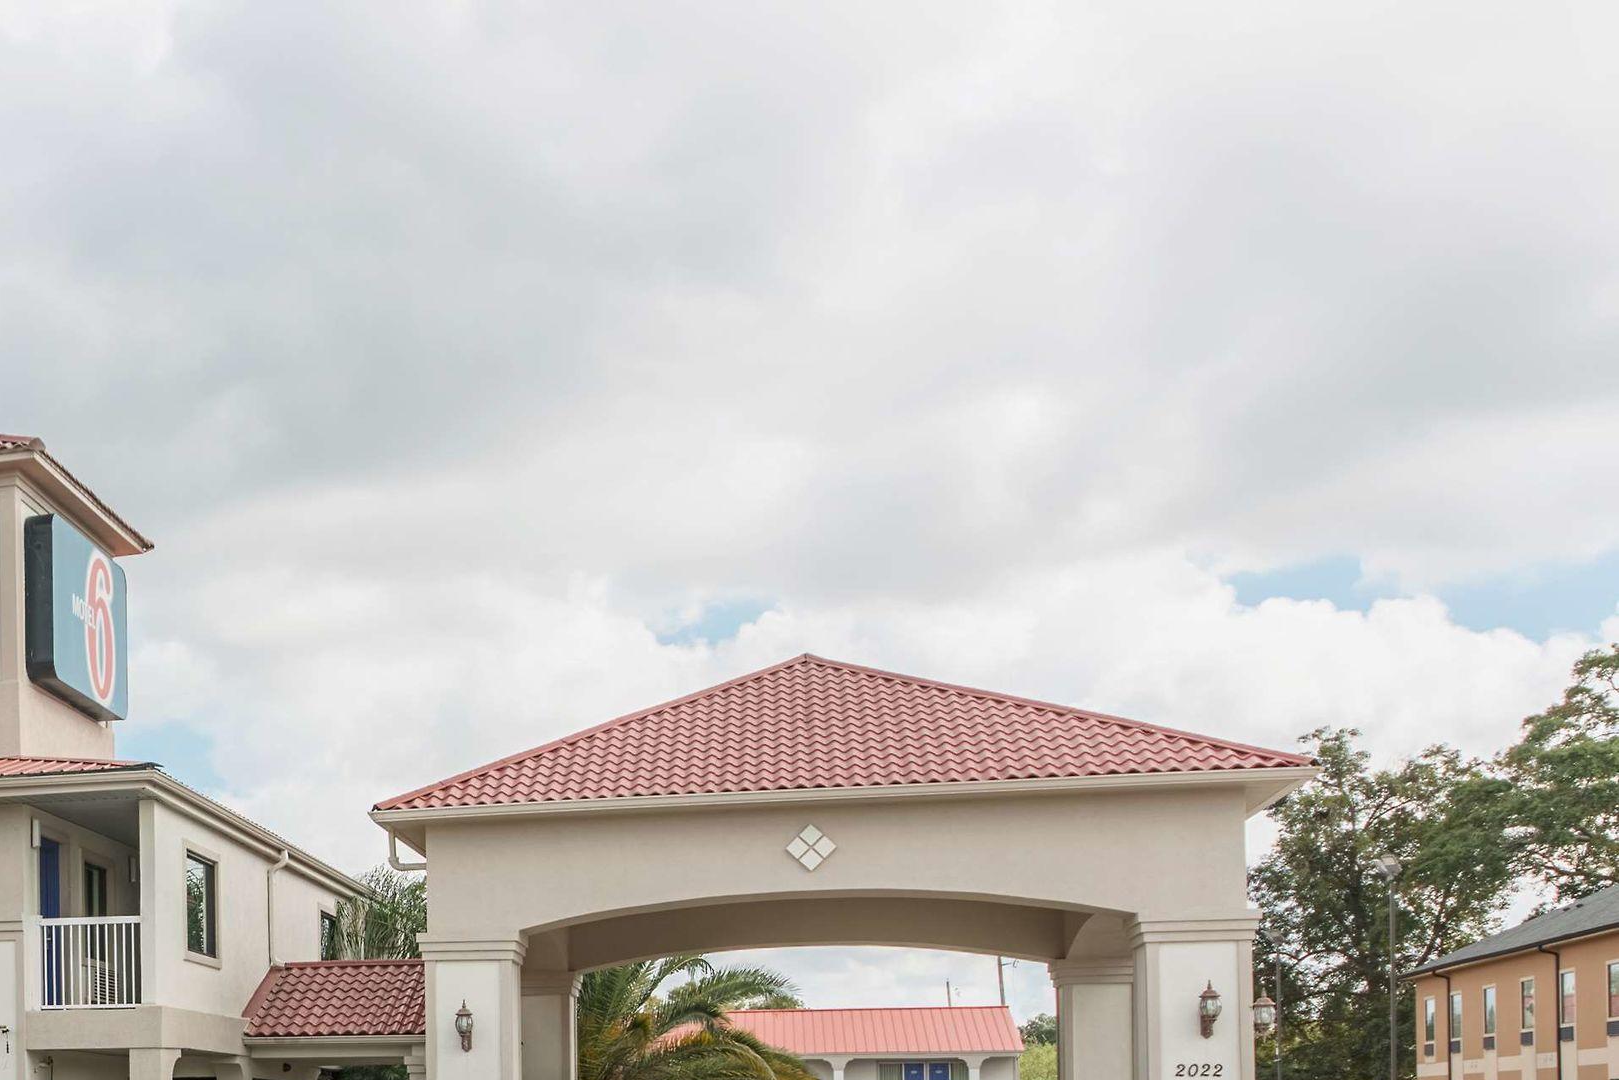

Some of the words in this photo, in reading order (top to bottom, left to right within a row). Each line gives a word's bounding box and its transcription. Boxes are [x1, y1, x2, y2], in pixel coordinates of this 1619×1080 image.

[72, 593, 96, 630] MOTEL
[87, 558, 114, 701] 6
[1175, 1063, 1223, 1077] 2022
